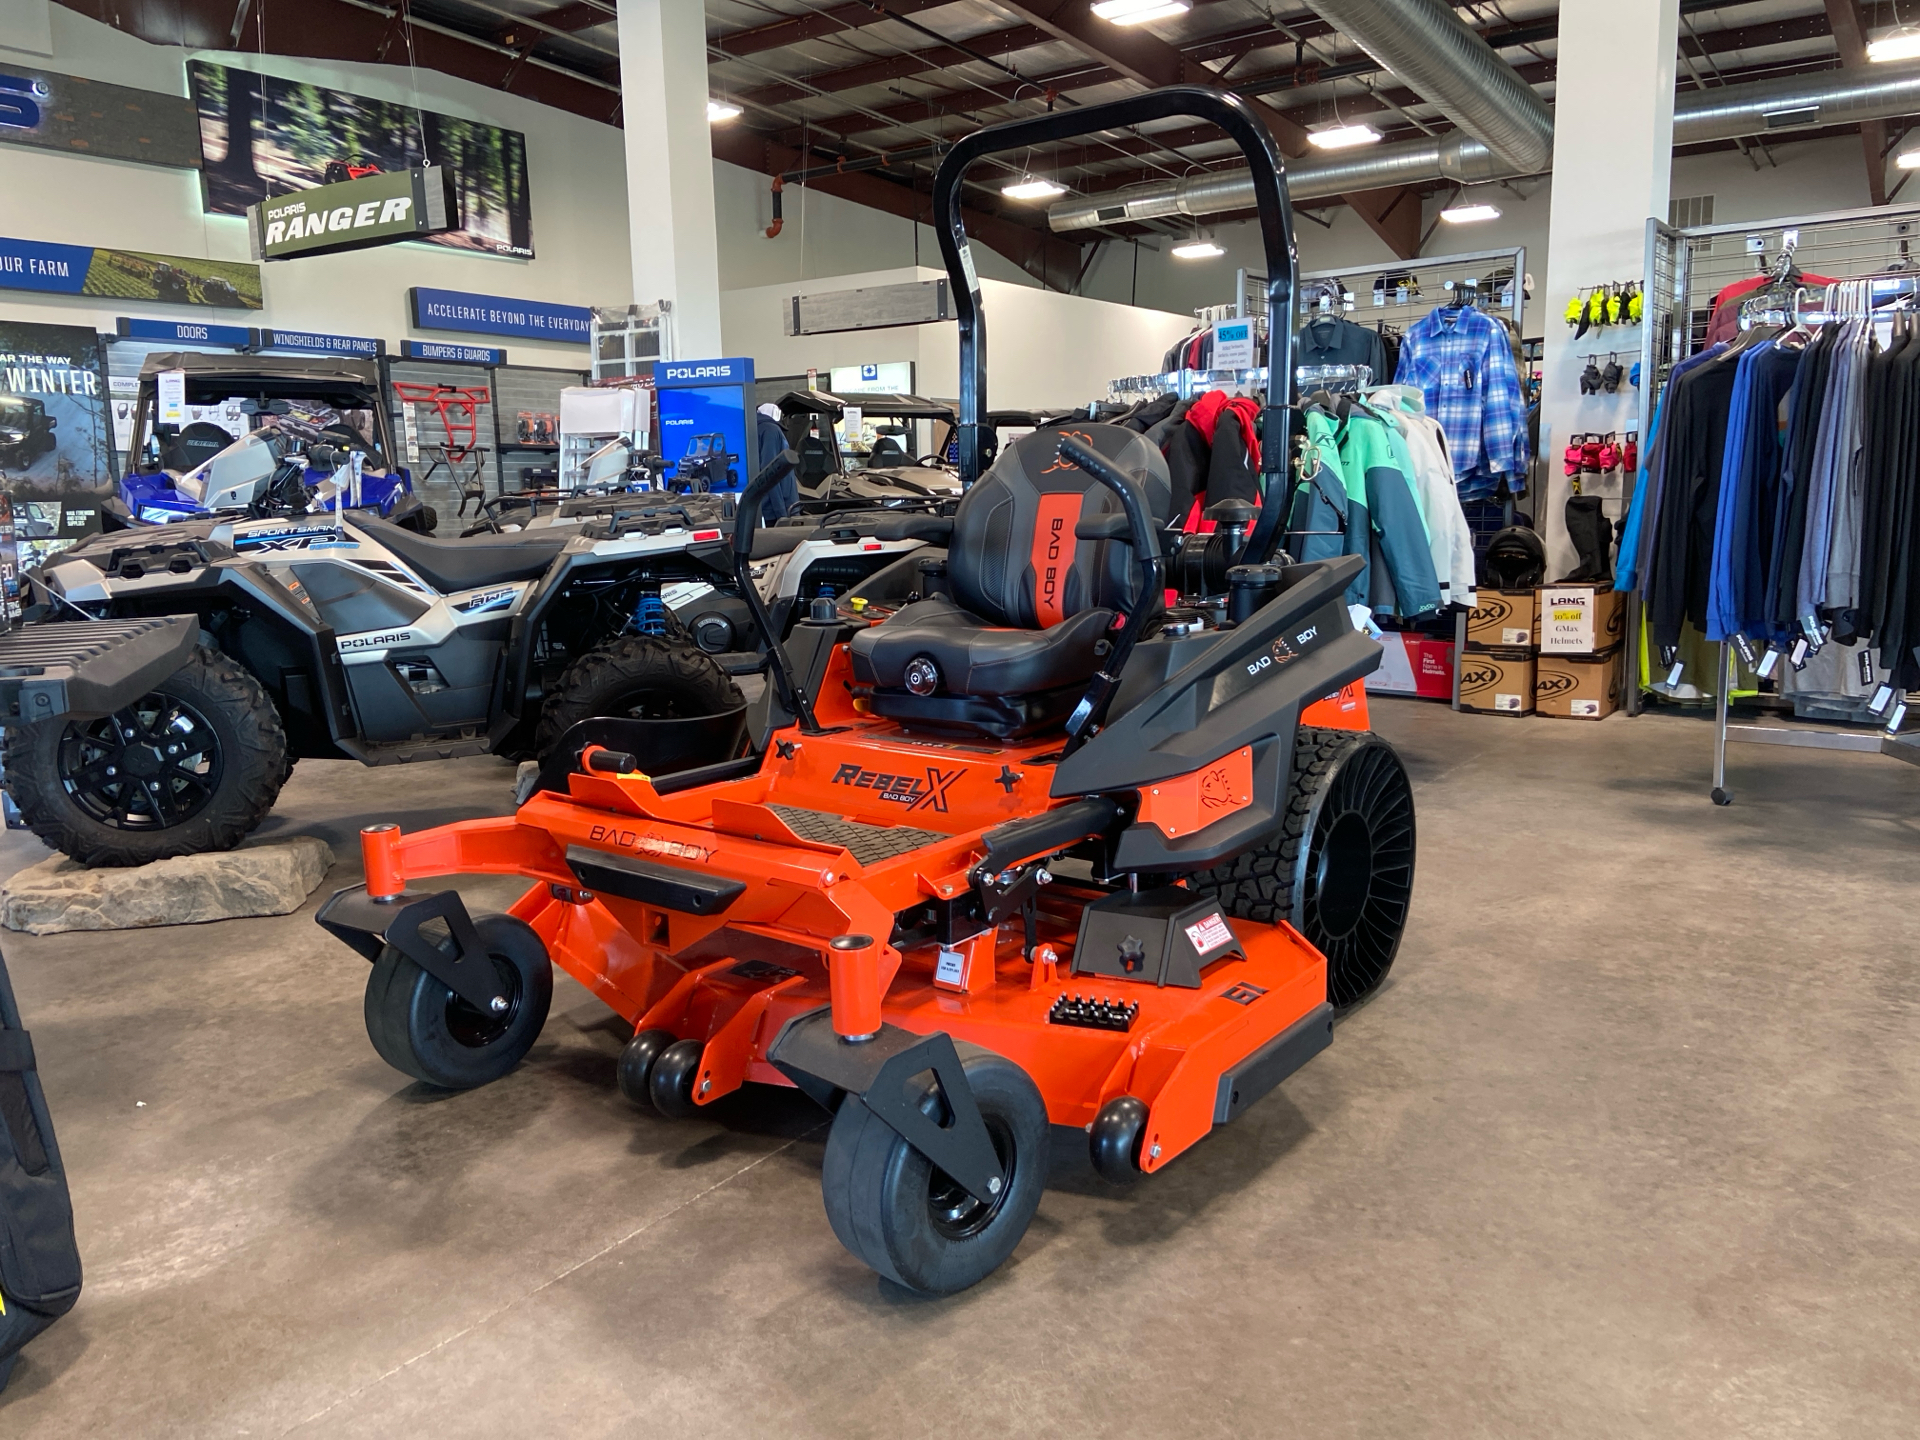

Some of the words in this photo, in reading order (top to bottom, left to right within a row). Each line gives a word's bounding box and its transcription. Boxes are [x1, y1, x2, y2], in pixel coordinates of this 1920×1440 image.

[267, 202, 307, 221] POLARIS
[265, 197, 412, 246] RANGER
[496, 244, 533, 256] POLARIS
[29, 258, 70, 277] FARM
[427, 303, 487, 322] ACCELERATE
[490, 310, 525, 326] BEYOND
[529, 314, 545, 328] THE
[548, 316, 590, 332] EVERYDAY
[176, 325, 208, 339] DOORS
[1235, 330, 1248, 338] OFF
[273, 333, 325, 349] WINDSHIELDS
[326, 338, 331, 349] &
[332, 338, 351, 351] REAR
[352, 341, 377, 352] PANELS
[18, 355, 43, 364] THE
[46, 356, 71, 365] WAY
[422, 344, 456, 359] BUMPERS
[457, 348, 462, 359] &
[464, 348, 490, 361] GUARDS
[6, 367, 97, 395] WINTER
[667, 365, 731, 379] POLARIS
[247, 525, 336, 538] SPORTSMAN
[1048, 518, 1064, 560] BAD
[248, 535, 338, 557] XP
[1044, 567, 1057, 610] BOY
[1550, 597, 1586, 606] LANG
[1554, 612, 1570, 621] 30%
[1570, 612, 1582, 620] off
[341, 632, 411, 650] POLARIS
[1550, 637, 1583, 645] Helmets
[1247, 655, 1271, 675] BAD
[1296, 626, 1318, 645] BOY
[883, 792, 899, 800] BAD
[899, 795, 916, 803] BOY
[590, 825, 636, 847] BAD
[667, 841, 718, 863] BOY
